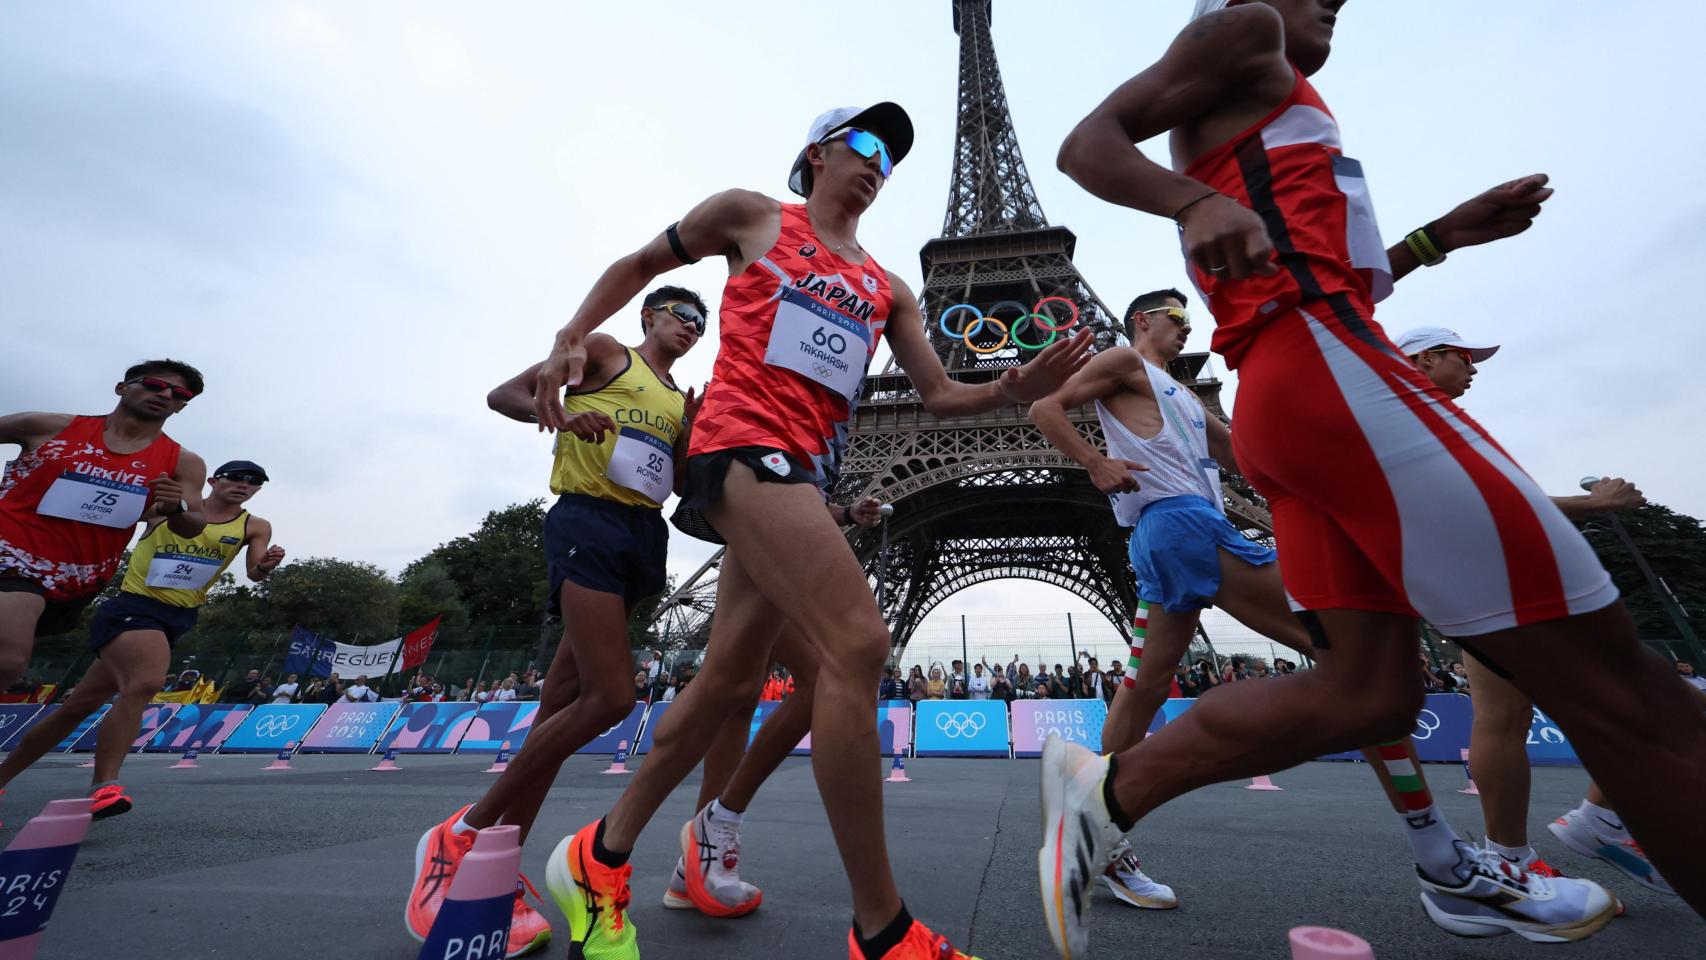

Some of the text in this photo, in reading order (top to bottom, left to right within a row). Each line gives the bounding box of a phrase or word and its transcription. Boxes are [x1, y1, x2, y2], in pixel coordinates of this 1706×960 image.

[796, 270, 875, 321] JAPAN
[811, 303, 860, 332] PARIS 2024
[812, 326, 847, 355] 60
[800, 341, 849, 373] TAKAHASHI
[645, 453, 665, 473] 25
[636, 466, 663, 485] ROMERO
[92, 490, 119, 506] 75
[81, 503, 113, 515] DEMIR
[173, 563, 194, 575] 24
[326, 726, 366, 738] 2024
[1036, 727, 1087, 741] 2024
[0, 893, 48, 917] 24
